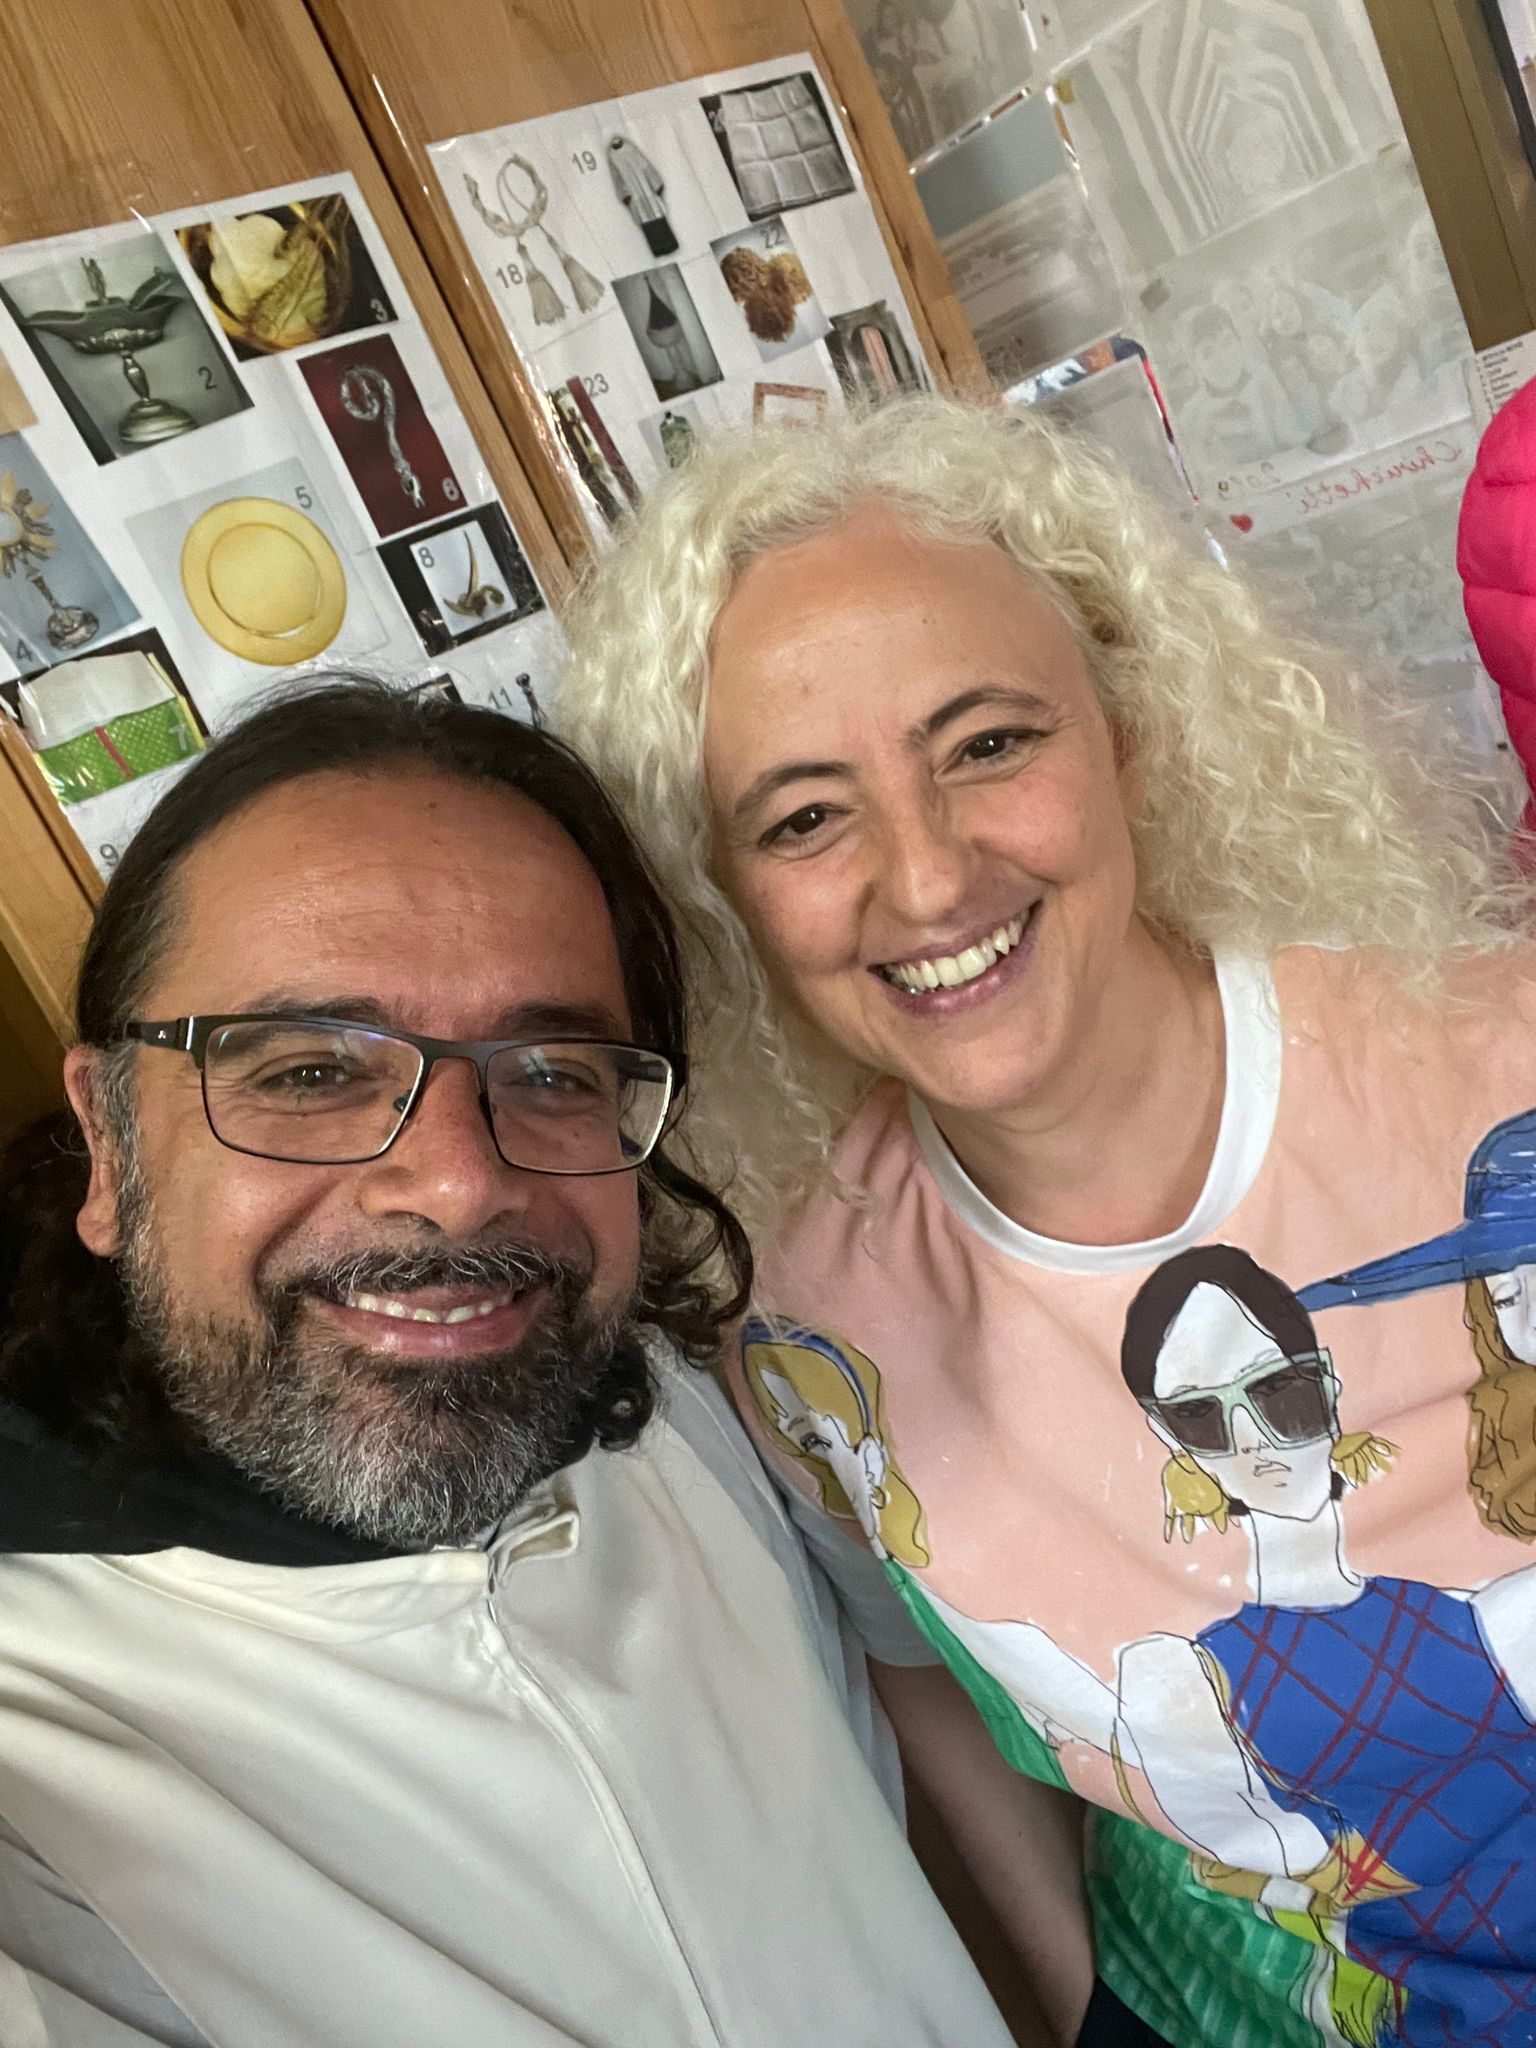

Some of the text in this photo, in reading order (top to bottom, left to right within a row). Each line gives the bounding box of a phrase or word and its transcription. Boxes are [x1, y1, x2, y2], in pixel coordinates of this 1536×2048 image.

[572, 150, 598, 174] 19
[760, 228, 784, 249] 22
[496, 263, 523, 289] 18
[370, 298, 388, 321] 3
[198, 366, 217, 390] 2
[583, 372, 609, 397] 23
[295, 485, 312, 509] 5
[442, 476, 459, 501] 6
[418, 546, 434, 569] 8
[16, 639, 32, 662] 4
[488, 685, 512, 710] 11
[169, 723, 187, 750] 7
[100, 843, 118, 866] 9
